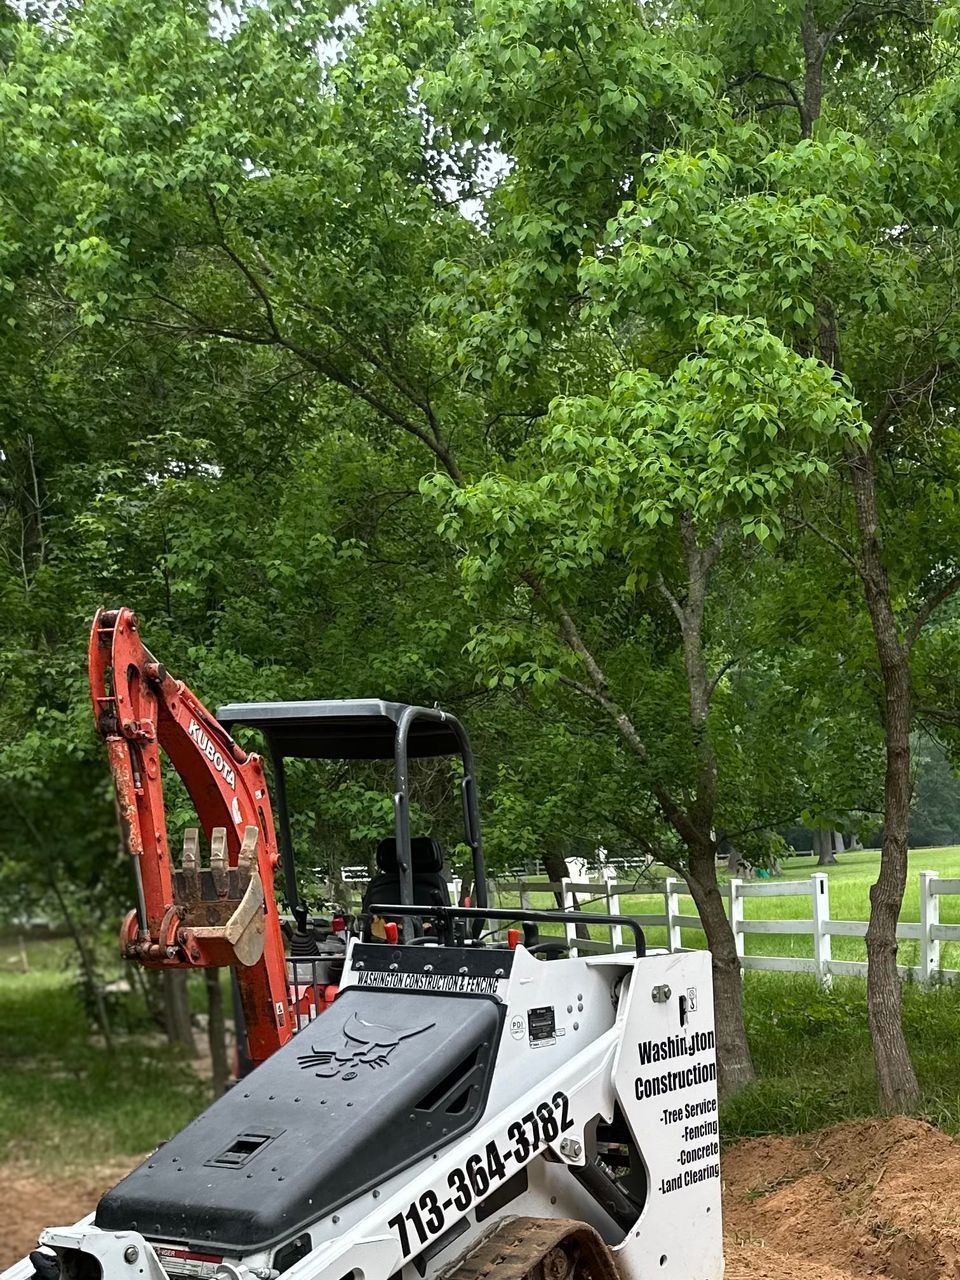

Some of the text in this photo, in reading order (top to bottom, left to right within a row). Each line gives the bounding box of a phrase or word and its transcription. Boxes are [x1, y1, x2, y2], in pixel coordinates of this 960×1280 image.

[188, 719, 237, 790] KUBOTA
[358, 971, 499, 993] WASHINGTON CONSTRUCTION & FENCING
[635, 1062, 716, 1101] Construction
[660, 1098, 717, 1126] -Tree Service
[681, 1120, 718, 1142] -Fencing
[677, 1142, 719, 1166] -Concrete
[387, 1091, 575, 1259] 713-364-3782
[658, 1163, 720, 1195] -Land Clearing
